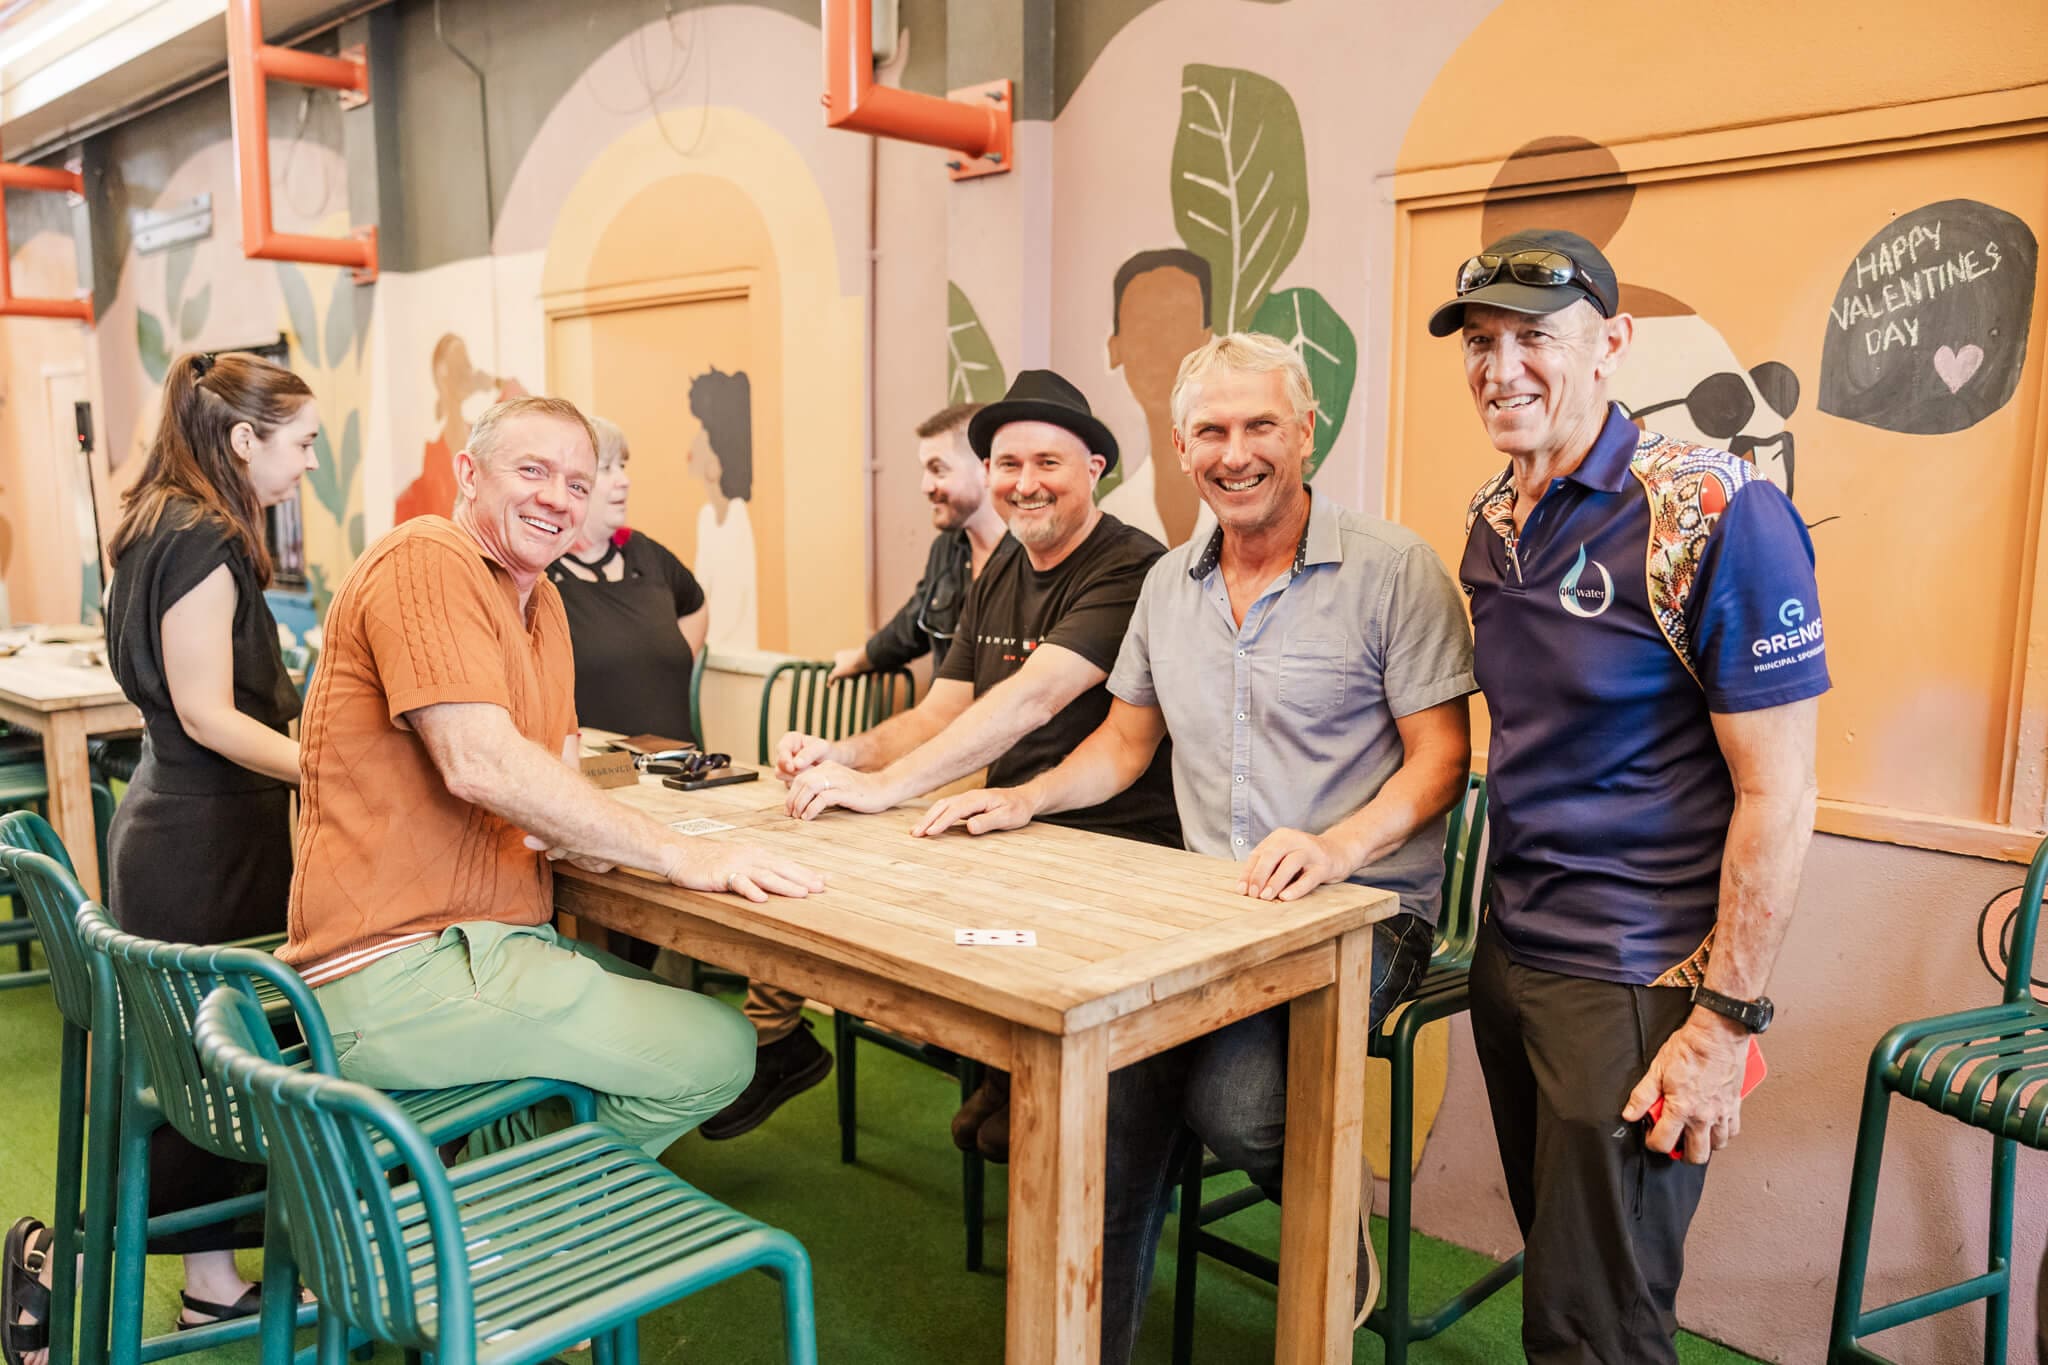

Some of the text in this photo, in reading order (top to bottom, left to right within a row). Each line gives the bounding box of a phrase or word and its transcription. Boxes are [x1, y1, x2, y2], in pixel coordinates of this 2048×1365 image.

[1856, 220, 1941, 289] HAPPY
[1831, 241, 2002, 331] VALENTINES
[1865, 318, 1919, 356] DAY
[1753, 656, 1798, 673] PRINCIPAL
